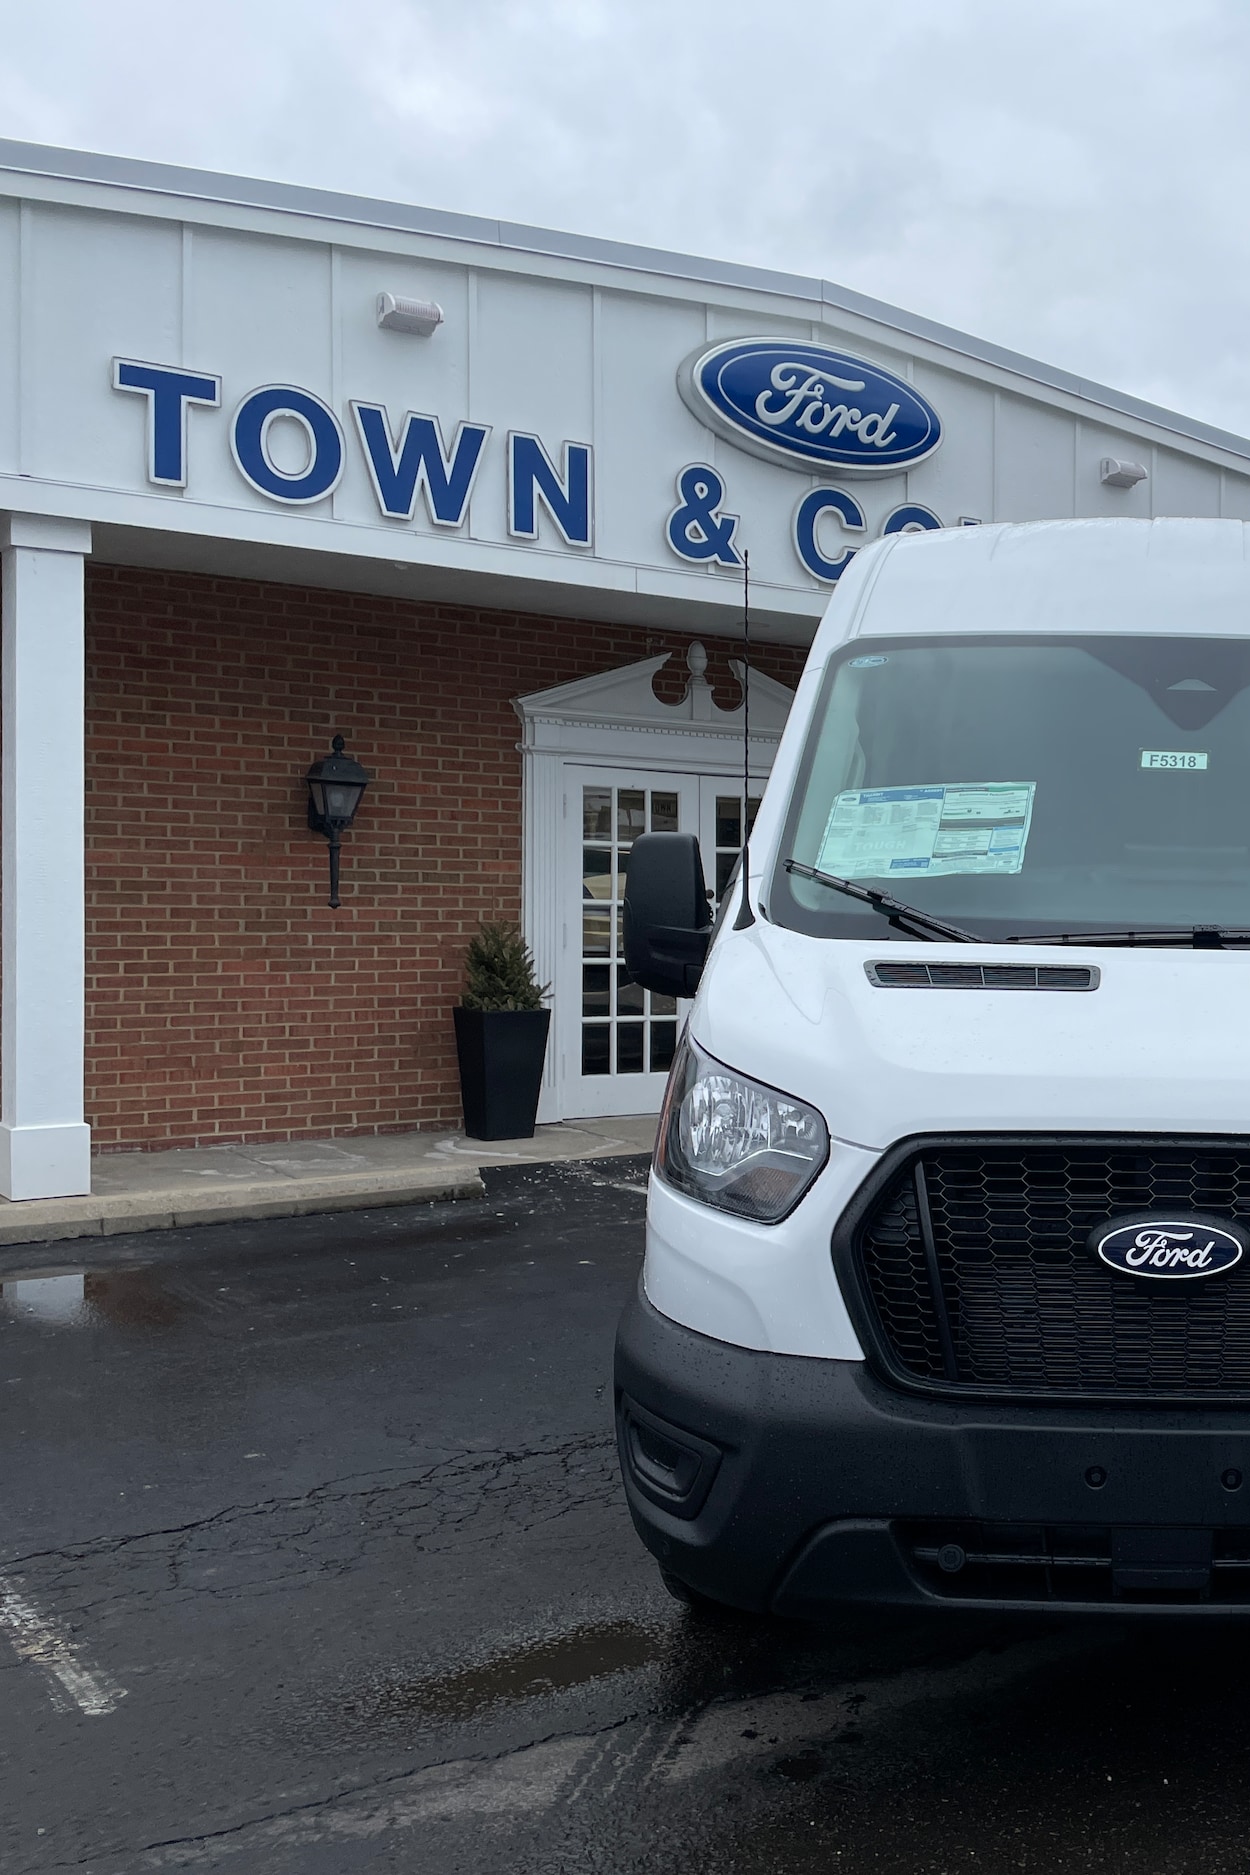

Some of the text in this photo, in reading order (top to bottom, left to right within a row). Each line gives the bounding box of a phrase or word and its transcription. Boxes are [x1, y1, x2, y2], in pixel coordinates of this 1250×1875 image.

[756, 362, 900, 448] Ford
[112, 356, 594, 547] TOWN
[666, 462, 749, 570] &
[1149, 754, 1197, 768] F5318
[1125, 1230, 1216, 1268] Ford
